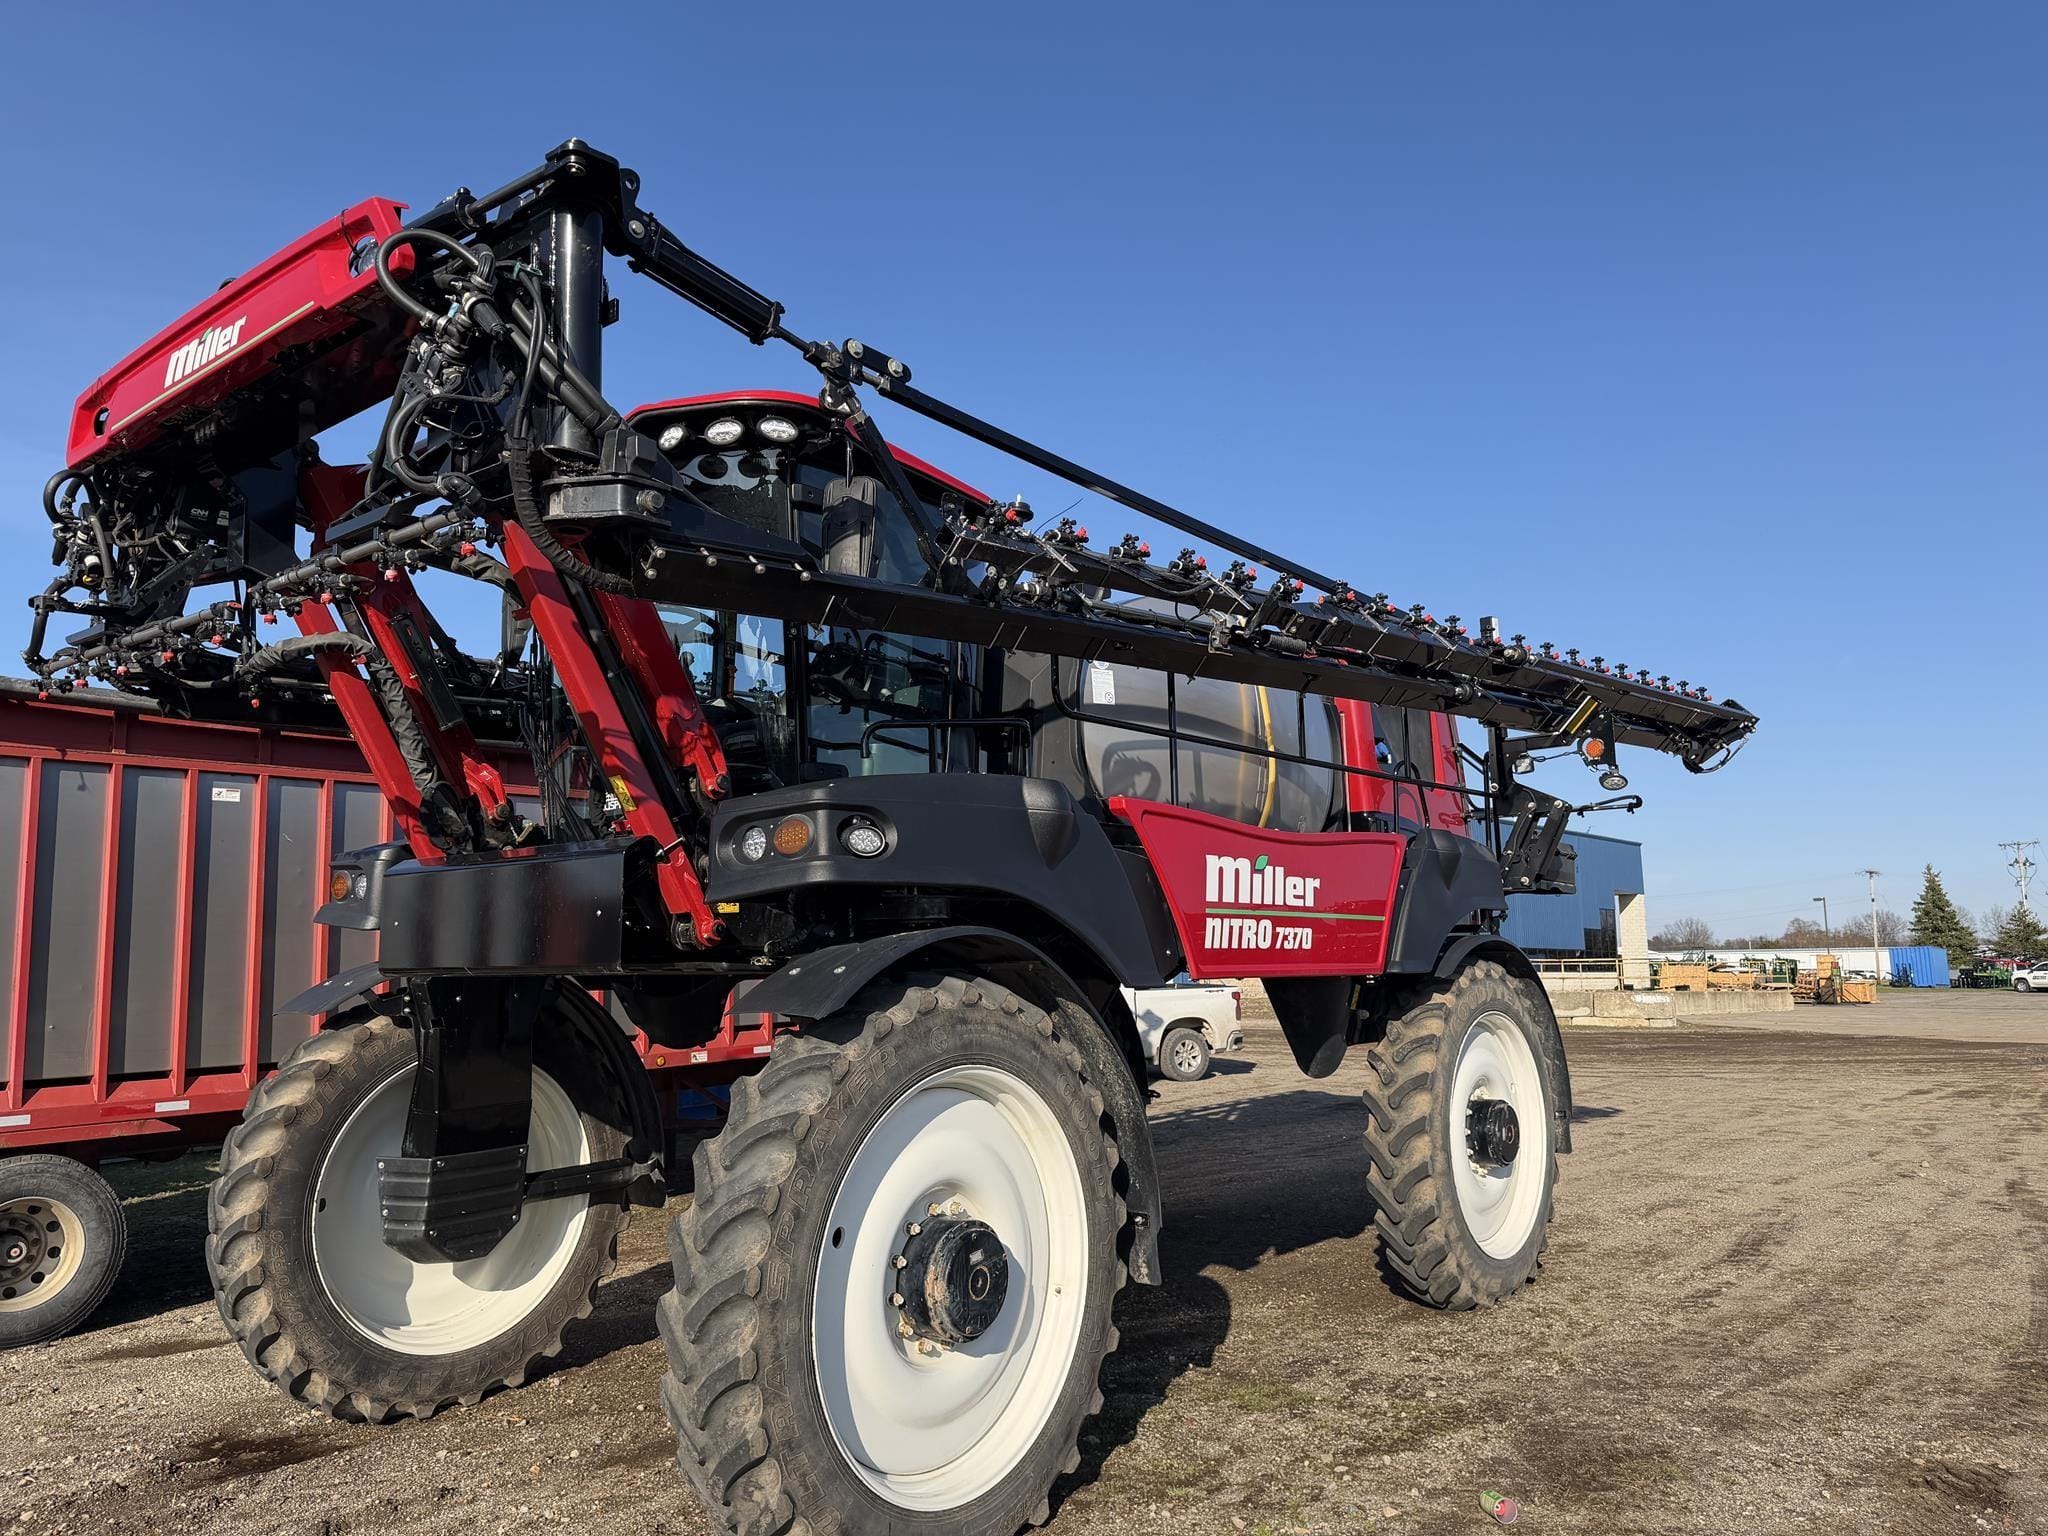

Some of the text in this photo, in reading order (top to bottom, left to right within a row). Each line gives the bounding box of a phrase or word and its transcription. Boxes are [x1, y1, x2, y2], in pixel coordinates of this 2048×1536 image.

[1204, 917, 1313, 950] NITRO 7370
[300, 1029, 414, 1127] ULTRA
[766, 1044, 898, 1301] SPRAYER
[379, 1248, 599, 1397] GOODYEAR
[765, 1354, 842, 1536] ULTRA
